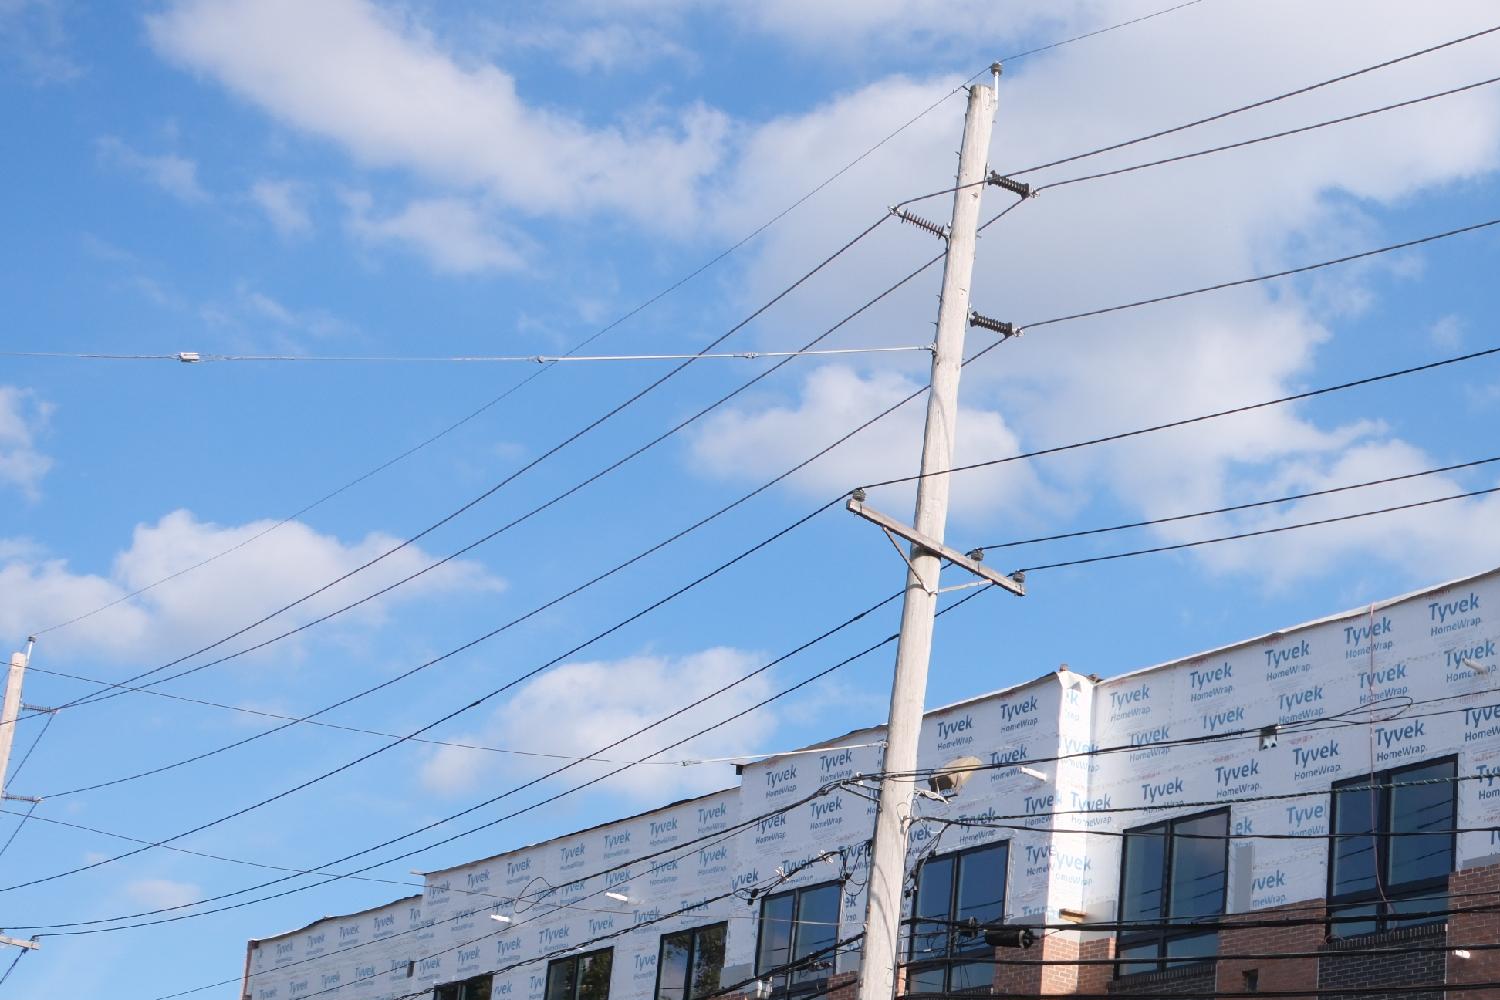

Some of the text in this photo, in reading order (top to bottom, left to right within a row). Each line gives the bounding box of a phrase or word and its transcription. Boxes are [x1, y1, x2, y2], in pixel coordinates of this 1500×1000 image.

[1428, 593, 1480, 624] Tyvek
[1344, 617, 1391, 647] Tyvek
[1430, 617, 1481, 636] HomeWrap
[1265, 640, 1309, 668] Tyvek
[1346, 640, 1393, 659] HomeWrap
[1443, 640, 1496, 669] Tyvek
[1190, 662, 1232, 690] Tyvek
[1267, 662, 1311, 681] HomeWrap
[1358, 663, 1408, 689] Tyvek
[1110, 684, 1150, 711] Tyvek
[1190, 684, 1233, 702] HomeWrap
[1279, 685, 1323, 712] Tyvek
[1359, 686, 1408, 704] HomeWrap
[1000, 696, 1037, 721] Tyvek
[1110, 706, 1151, 722] HomeWrap
[1202, 706, 1245, 731] Tyvek
[1279, 706, 1324, 724] HomeWrap
[937, 715, 973, 740] Tyvek
[1129, 725, 1169, 749] Tyvek
[1375, 719, 1425, 748] Tyvek
[937, 736, 973, 751] HomeWrap
[1293, 739, 1339, 768] Tyvek
[1376, 743, 1426, 762] HomeWrap
[820, 749, 852, 772] Tyvek
[989, 744, 1027, 769] Tyvek
[1130, 746, 1170, 762] HomeWrap
[765, 764, 797, 788] Tyvek
[1216, 758, 1259, 785] Tyvek
[1294, 763, 1341, 781] HomeWrap
[1142, 777, 1183, 802] Tyvek
[1216, 781, 1260, 798] HomeWrap
[698, 802, 727, 823] Tyvek
[810, 796, 843, 819] Tyvek
[650, 818, 678, 838] Tyvek
[756, 813, 786, 835] Tyvek
[1235, 817, 1253, 835] ek
[604, 831, 631, 849] Tyvek
[560, 843, 585, 861] Tyvek
[699, 847, 727, 867] Tyvek
[507, 858, 531, 876] Tyvek
[651, 857, 678, 876] Tyvek
[467, 869, 491, 887] Tyvek
[373, 914, 394, 929] Tyvek
[589, 917, 614, 935] Tyvek
[545, 926, 569, 943] Tyvek
[457, 946, 480, 964] Tyvek
[498, 937, 521, 954] Tyvek
